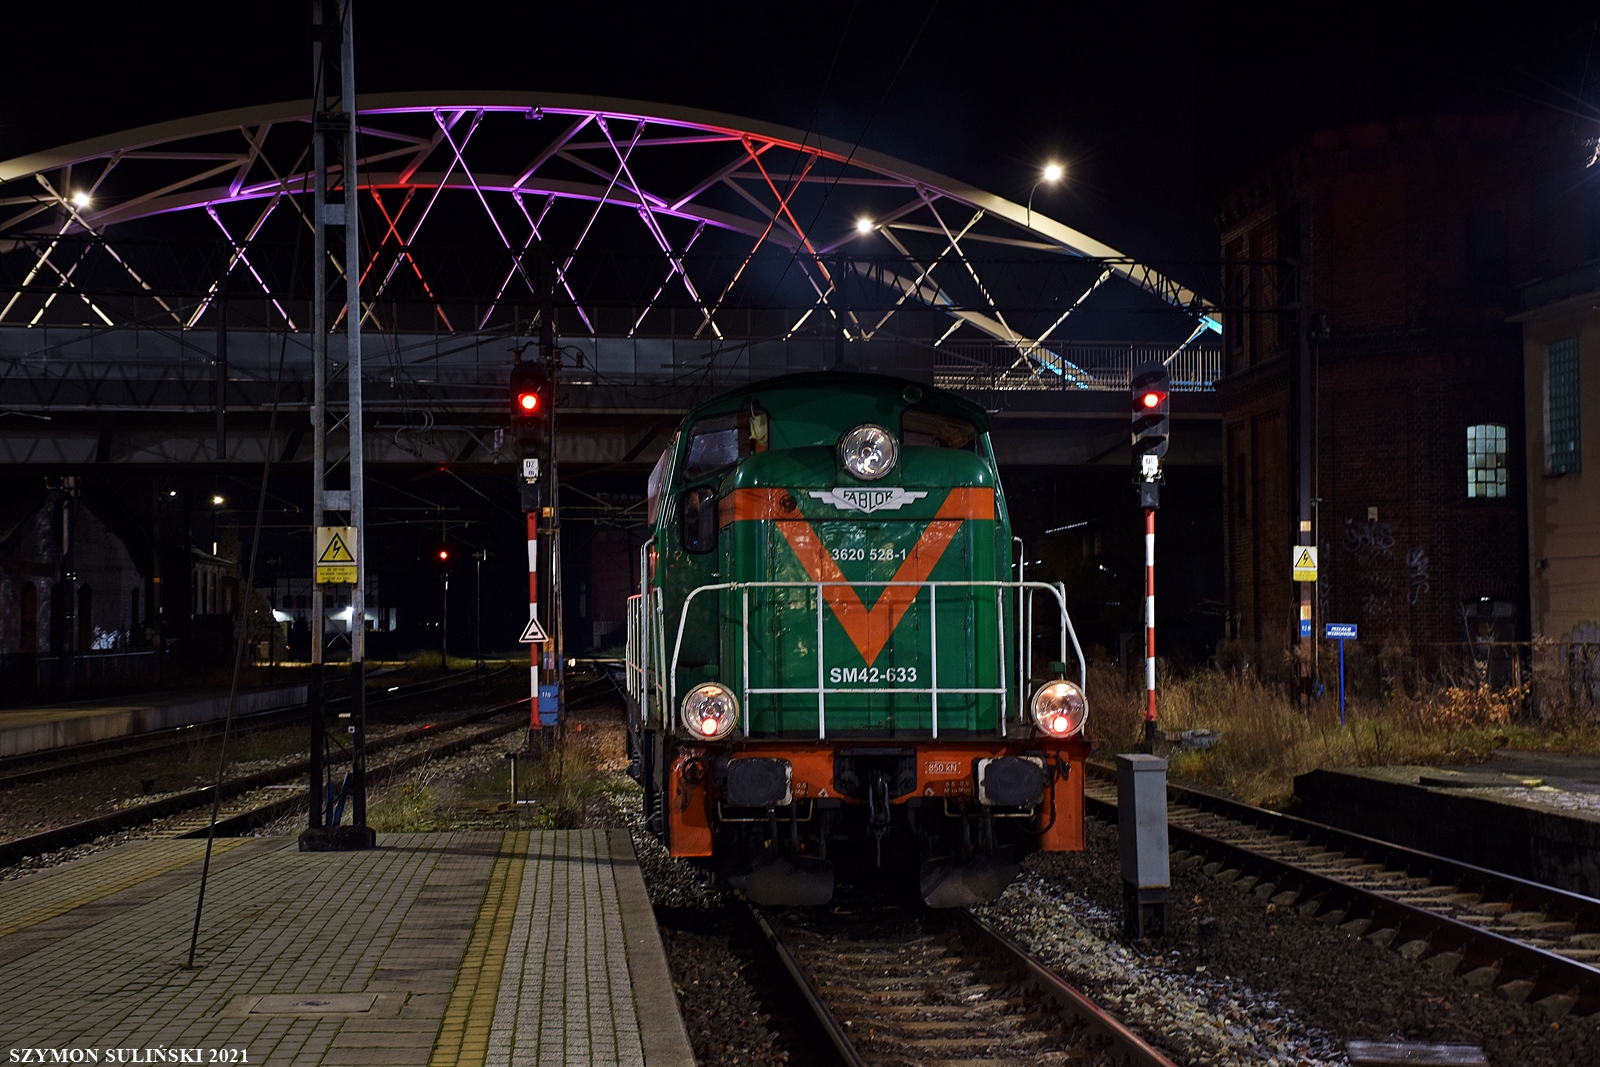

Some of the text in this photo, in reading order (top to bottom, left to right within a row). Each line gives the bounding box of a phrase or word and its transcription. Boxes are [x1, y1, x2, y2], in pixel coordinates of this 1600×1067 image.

[844, 490, 893, 512] FABLOK
[832, 548, 907, 561] 3620 528-1
[829, 667, 918, 684] SM42-633
[928, 763, 944, 773] 850
